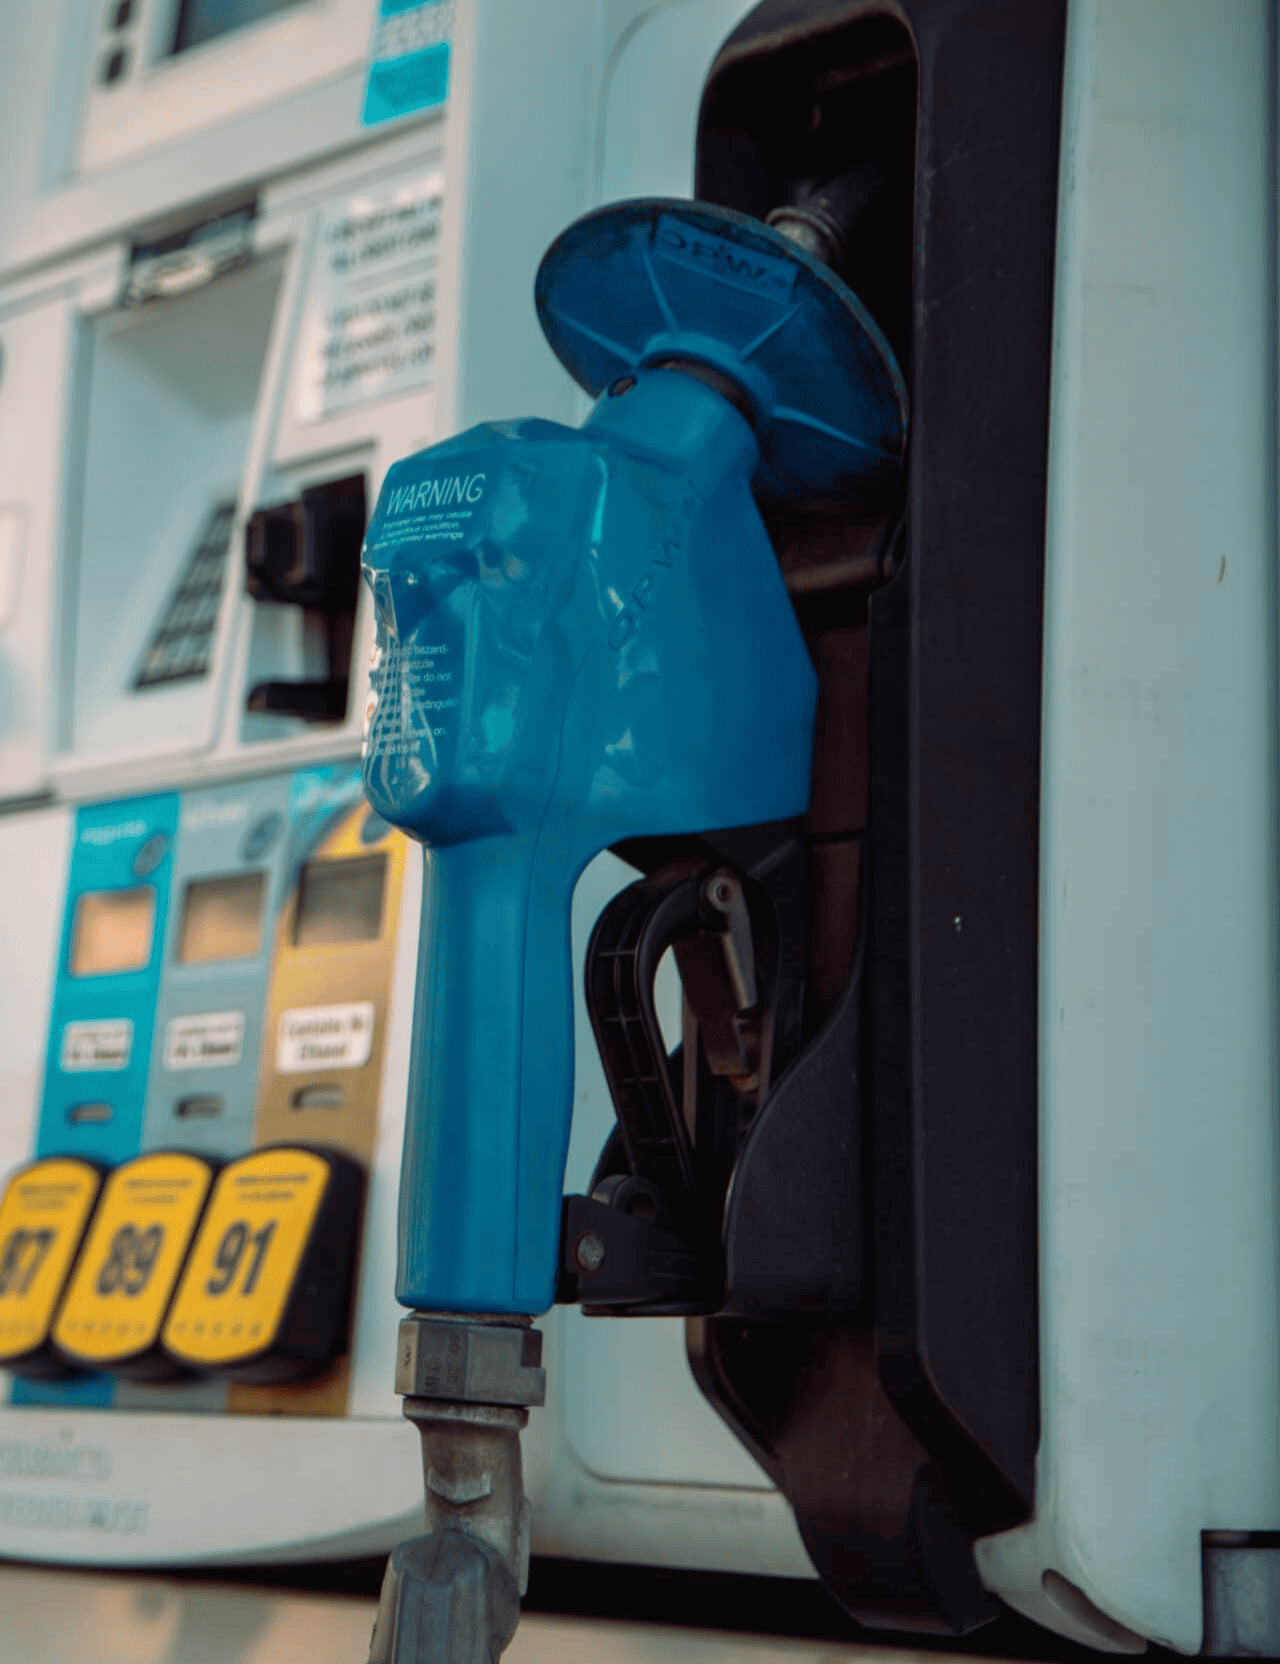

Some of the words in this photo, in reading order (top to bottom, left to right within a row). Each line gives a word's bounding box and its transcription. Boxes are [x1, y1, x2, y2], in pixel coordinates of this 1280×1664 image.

[386, 473, 487, 516] WARNING
[95, 1221, 167, 1298] 89
[205, 1217, 280, 1298] 91
